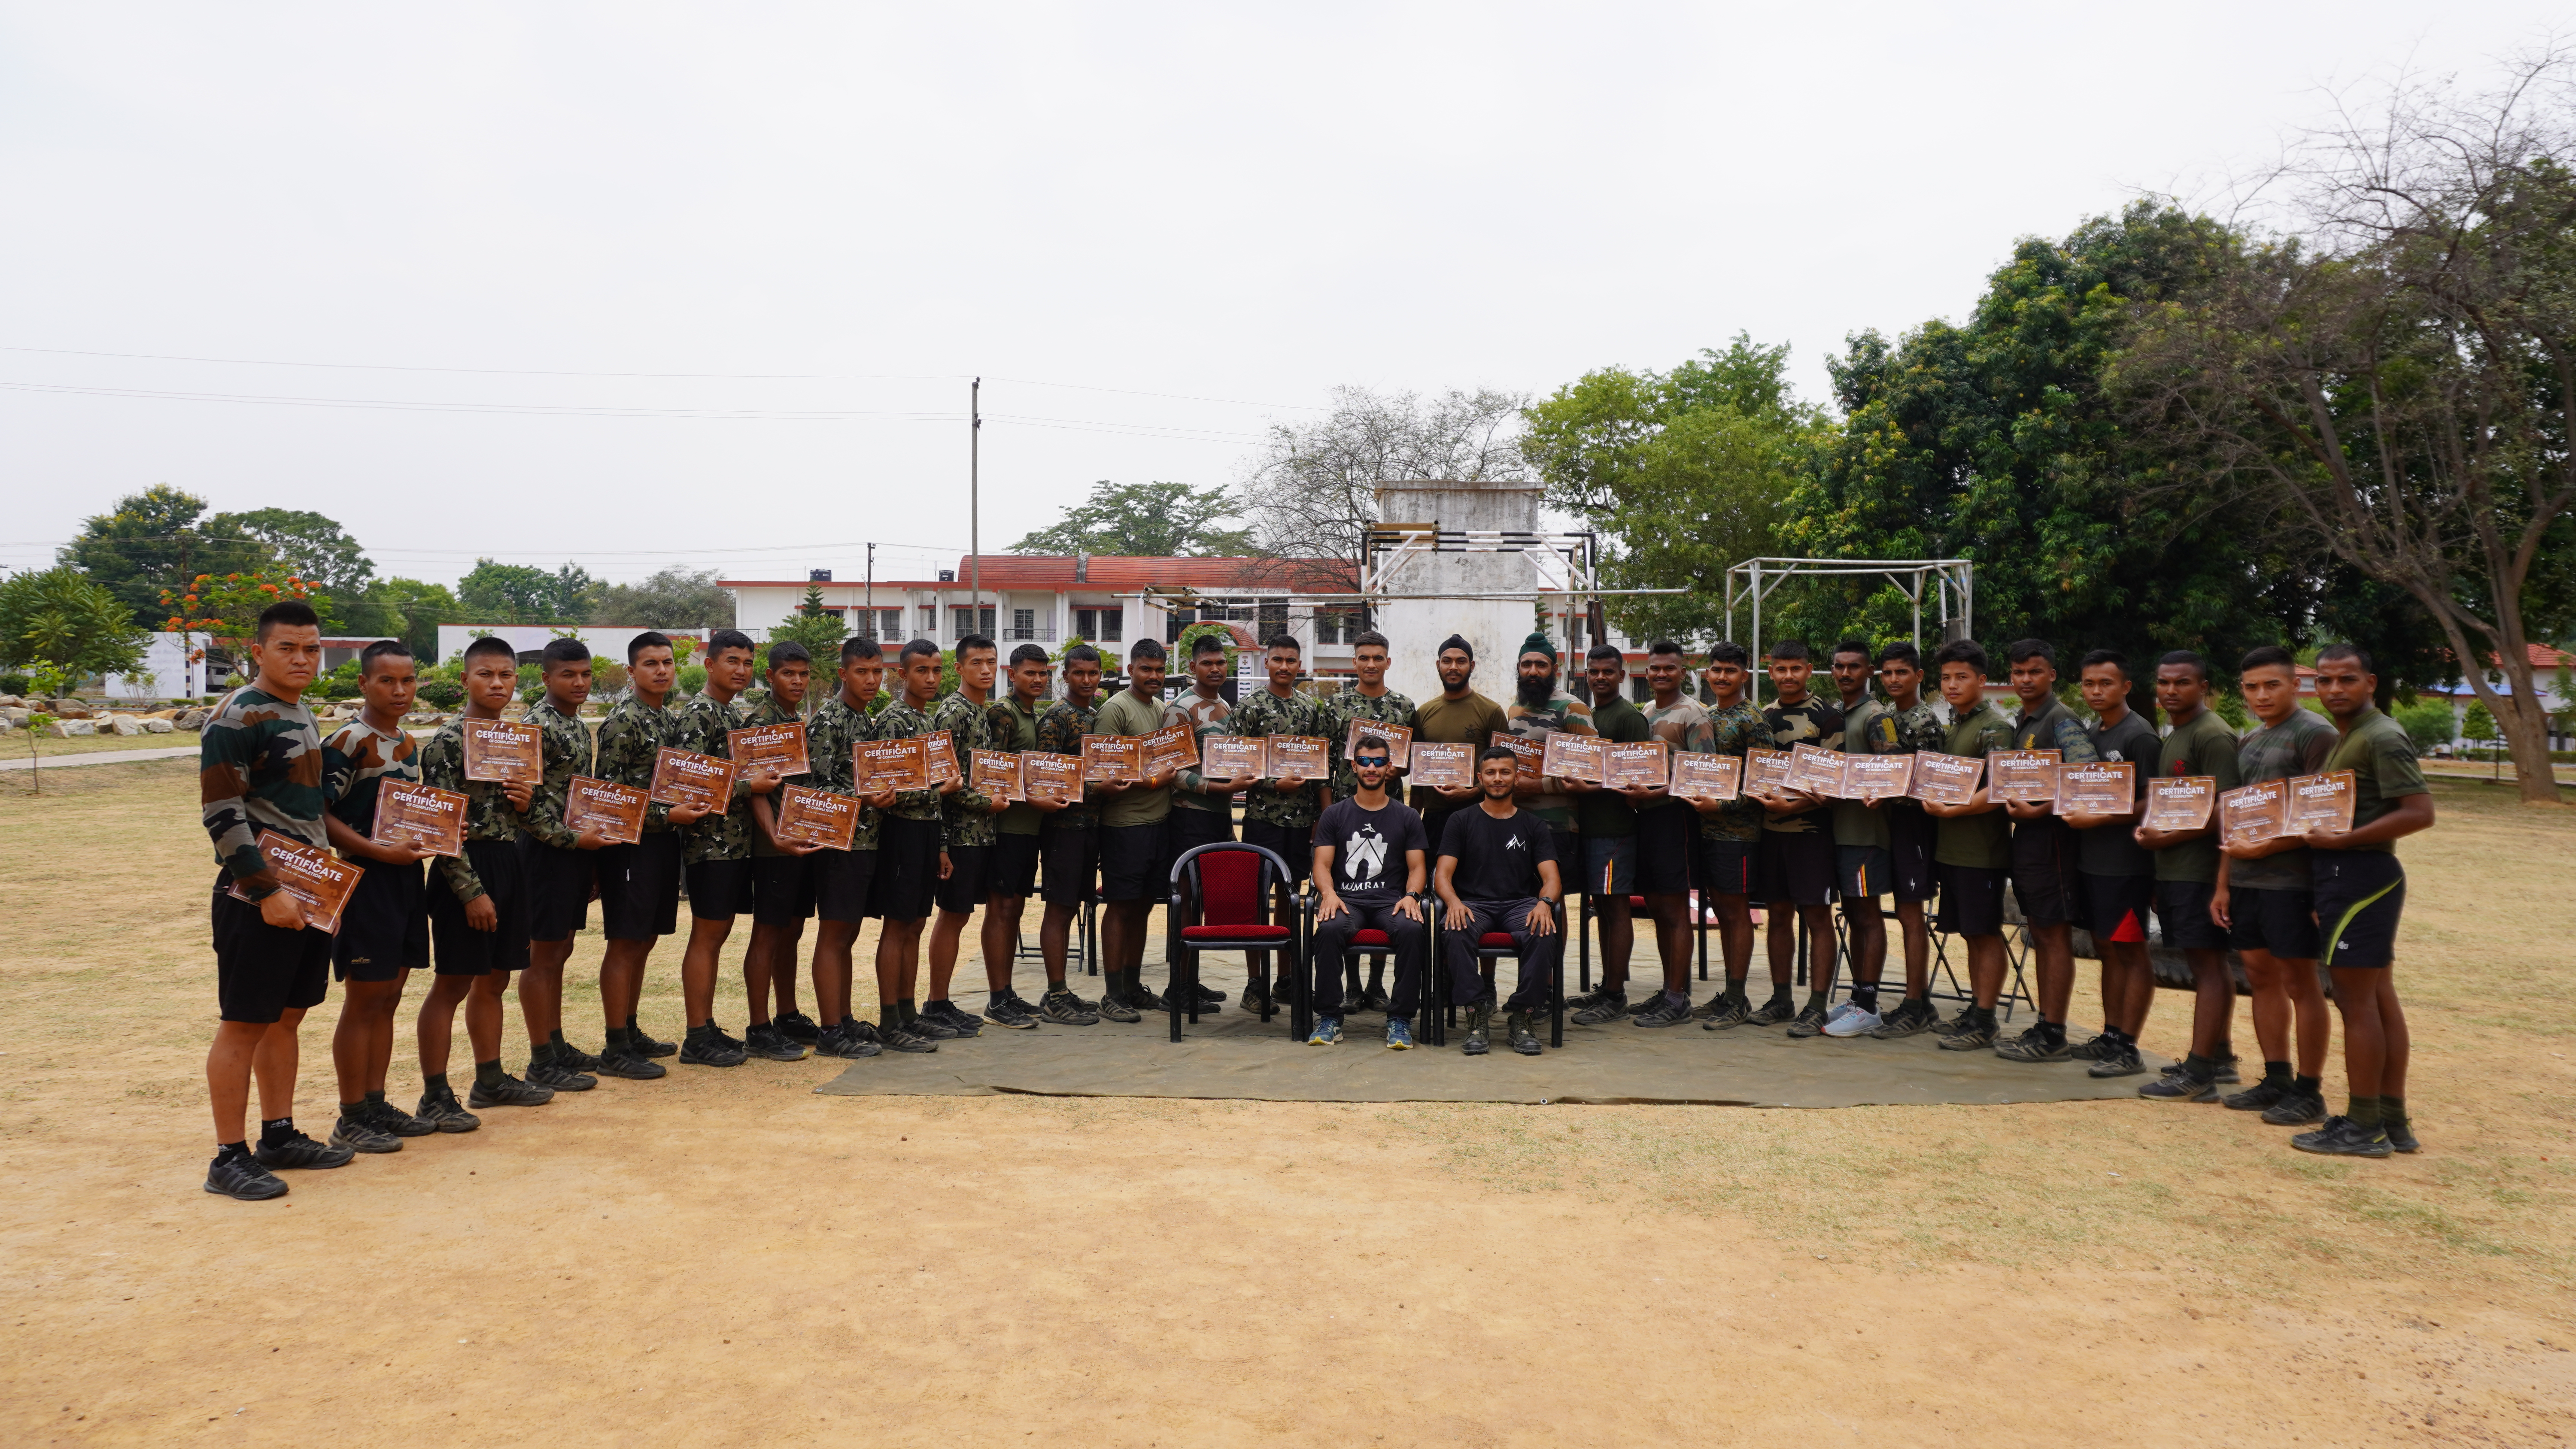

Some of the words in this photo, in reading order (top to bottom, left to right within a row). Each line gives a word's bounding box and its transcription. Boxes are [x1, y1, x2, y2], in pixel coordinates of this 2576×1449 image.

[476, 730, 530, 742] CERTIFICATE
[740, 731, 794, 745] CERTIFICATE
[1142, 730, 1184, 747] CERTIFICATE
[1359, 726, 1402, 739] CERTIFICATE
[927, 739, 948, 749] RTIFICATE
[1276, 742, 1319, 750] CERTIFICATE
[1500, 741, 1542, 755] CERTIFICATE
[1556, 740, 1601, 752] CERTIFICATE
[864, 746, 917, 757] CERTIFICATE
[1611, 749, 1657, 757] CERTIFICATE
[668, 758, 724, 775] CERTIFICATE
[979, 757, 1014, 768] CERTIFICATE
[1030, 759, 1075, 770] CERTIFICATE
[1683, 760, 1731, 770] CERTIFICATE
[1756, 756, 1790, 767] CERTIFIC
[1925, 760, 1973, 773] CERTIFICATE
[2000, 759, 2050, 767] CERTIFICATE
[2068, 771, 2123, 779] CERTIFICATE
[2159, 786, 2205, 795] CERTIFICATE
[2300, 782, 2345, 795] CERTIFICATE
[392, 791, 454, 811] CERTIFICATE
[581, 787, 637, 804] CERTIFICATE
[2229, 791, 2277, 807] CERTIFICATE
[412, 803, 438, 812] COMPLETION
[794, 795, 848, 812] CERTIFICATE
[270, 847, 343, 882] CERTIFICATE
[291, 864, 322, 879] COMPLETION
[1340, 881, 1385, 891] MUMBAI
